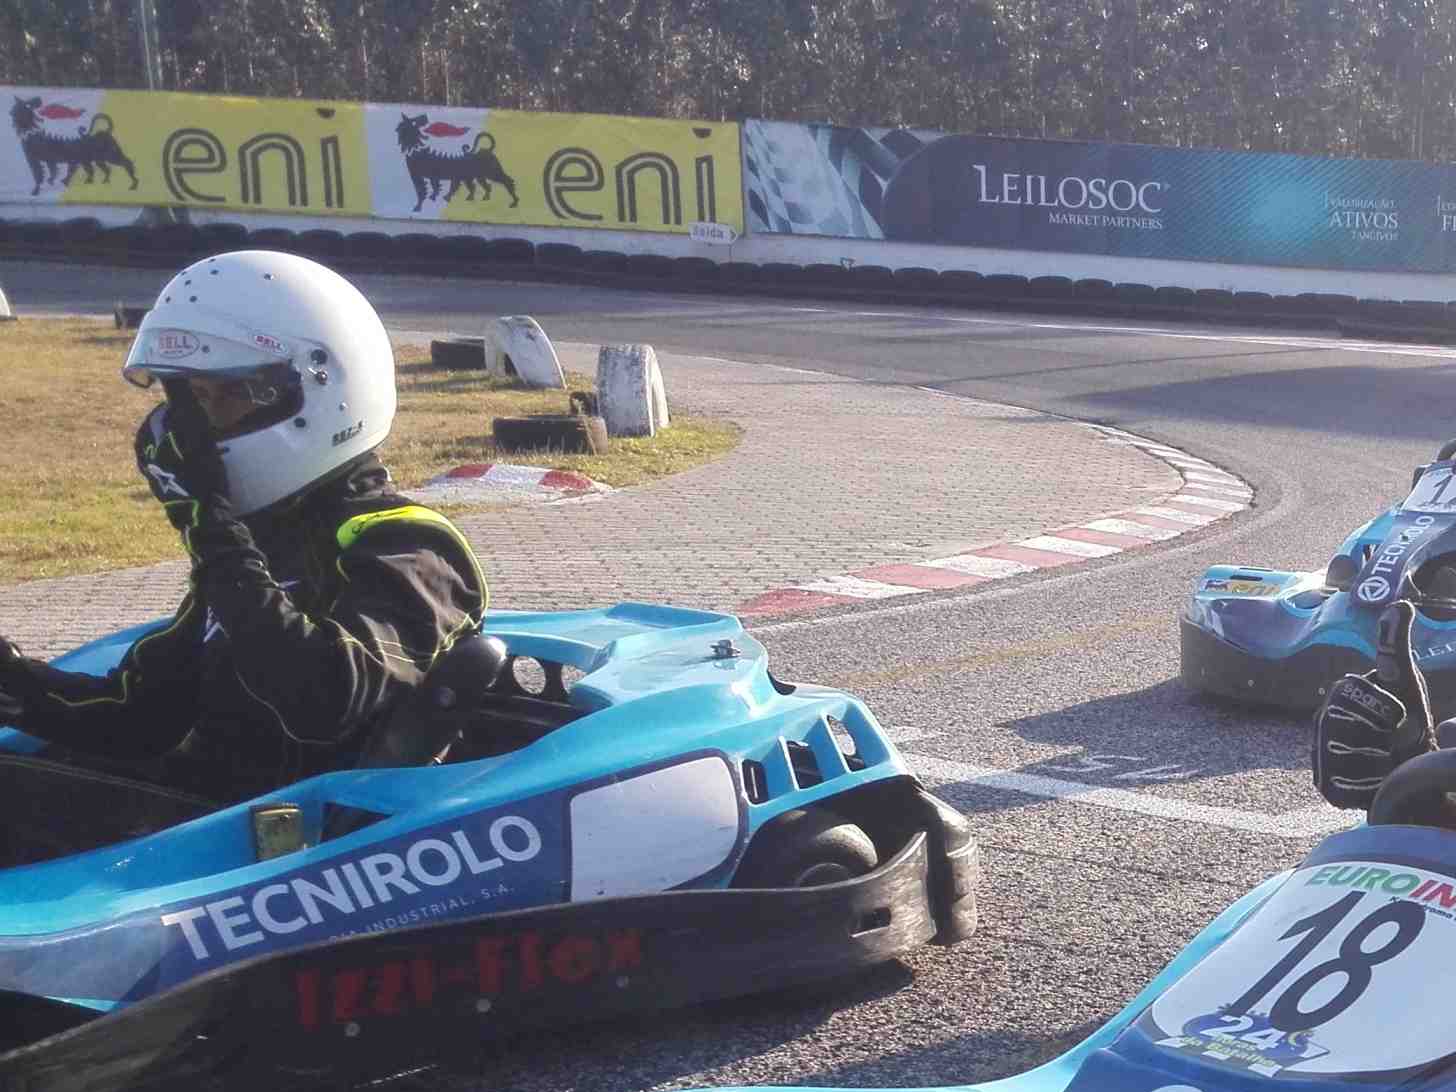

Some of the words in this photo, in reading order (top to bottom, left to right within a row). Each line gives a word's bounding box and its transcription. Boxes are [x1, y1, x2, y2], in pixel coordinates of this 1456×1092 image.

[163, 107, 344, 208] eni
[543, 128, 717, 225] eni
[972, 164, 1162, 213] LEILOSOC
[1049, 211, 1100, 227] MARKET
[1102, 215, 1163, 231] PARTNERS
[1328, 211, 1399, 230] ATIVOS
[159, 336, 193, 350] BELL
[255, 335, 283, 350] BELL
[162, 814, 542, 960] TECNIROLO
[1231, 890, 1428, 1033] 18
[1199, 1014, 1288, 1050] 24
